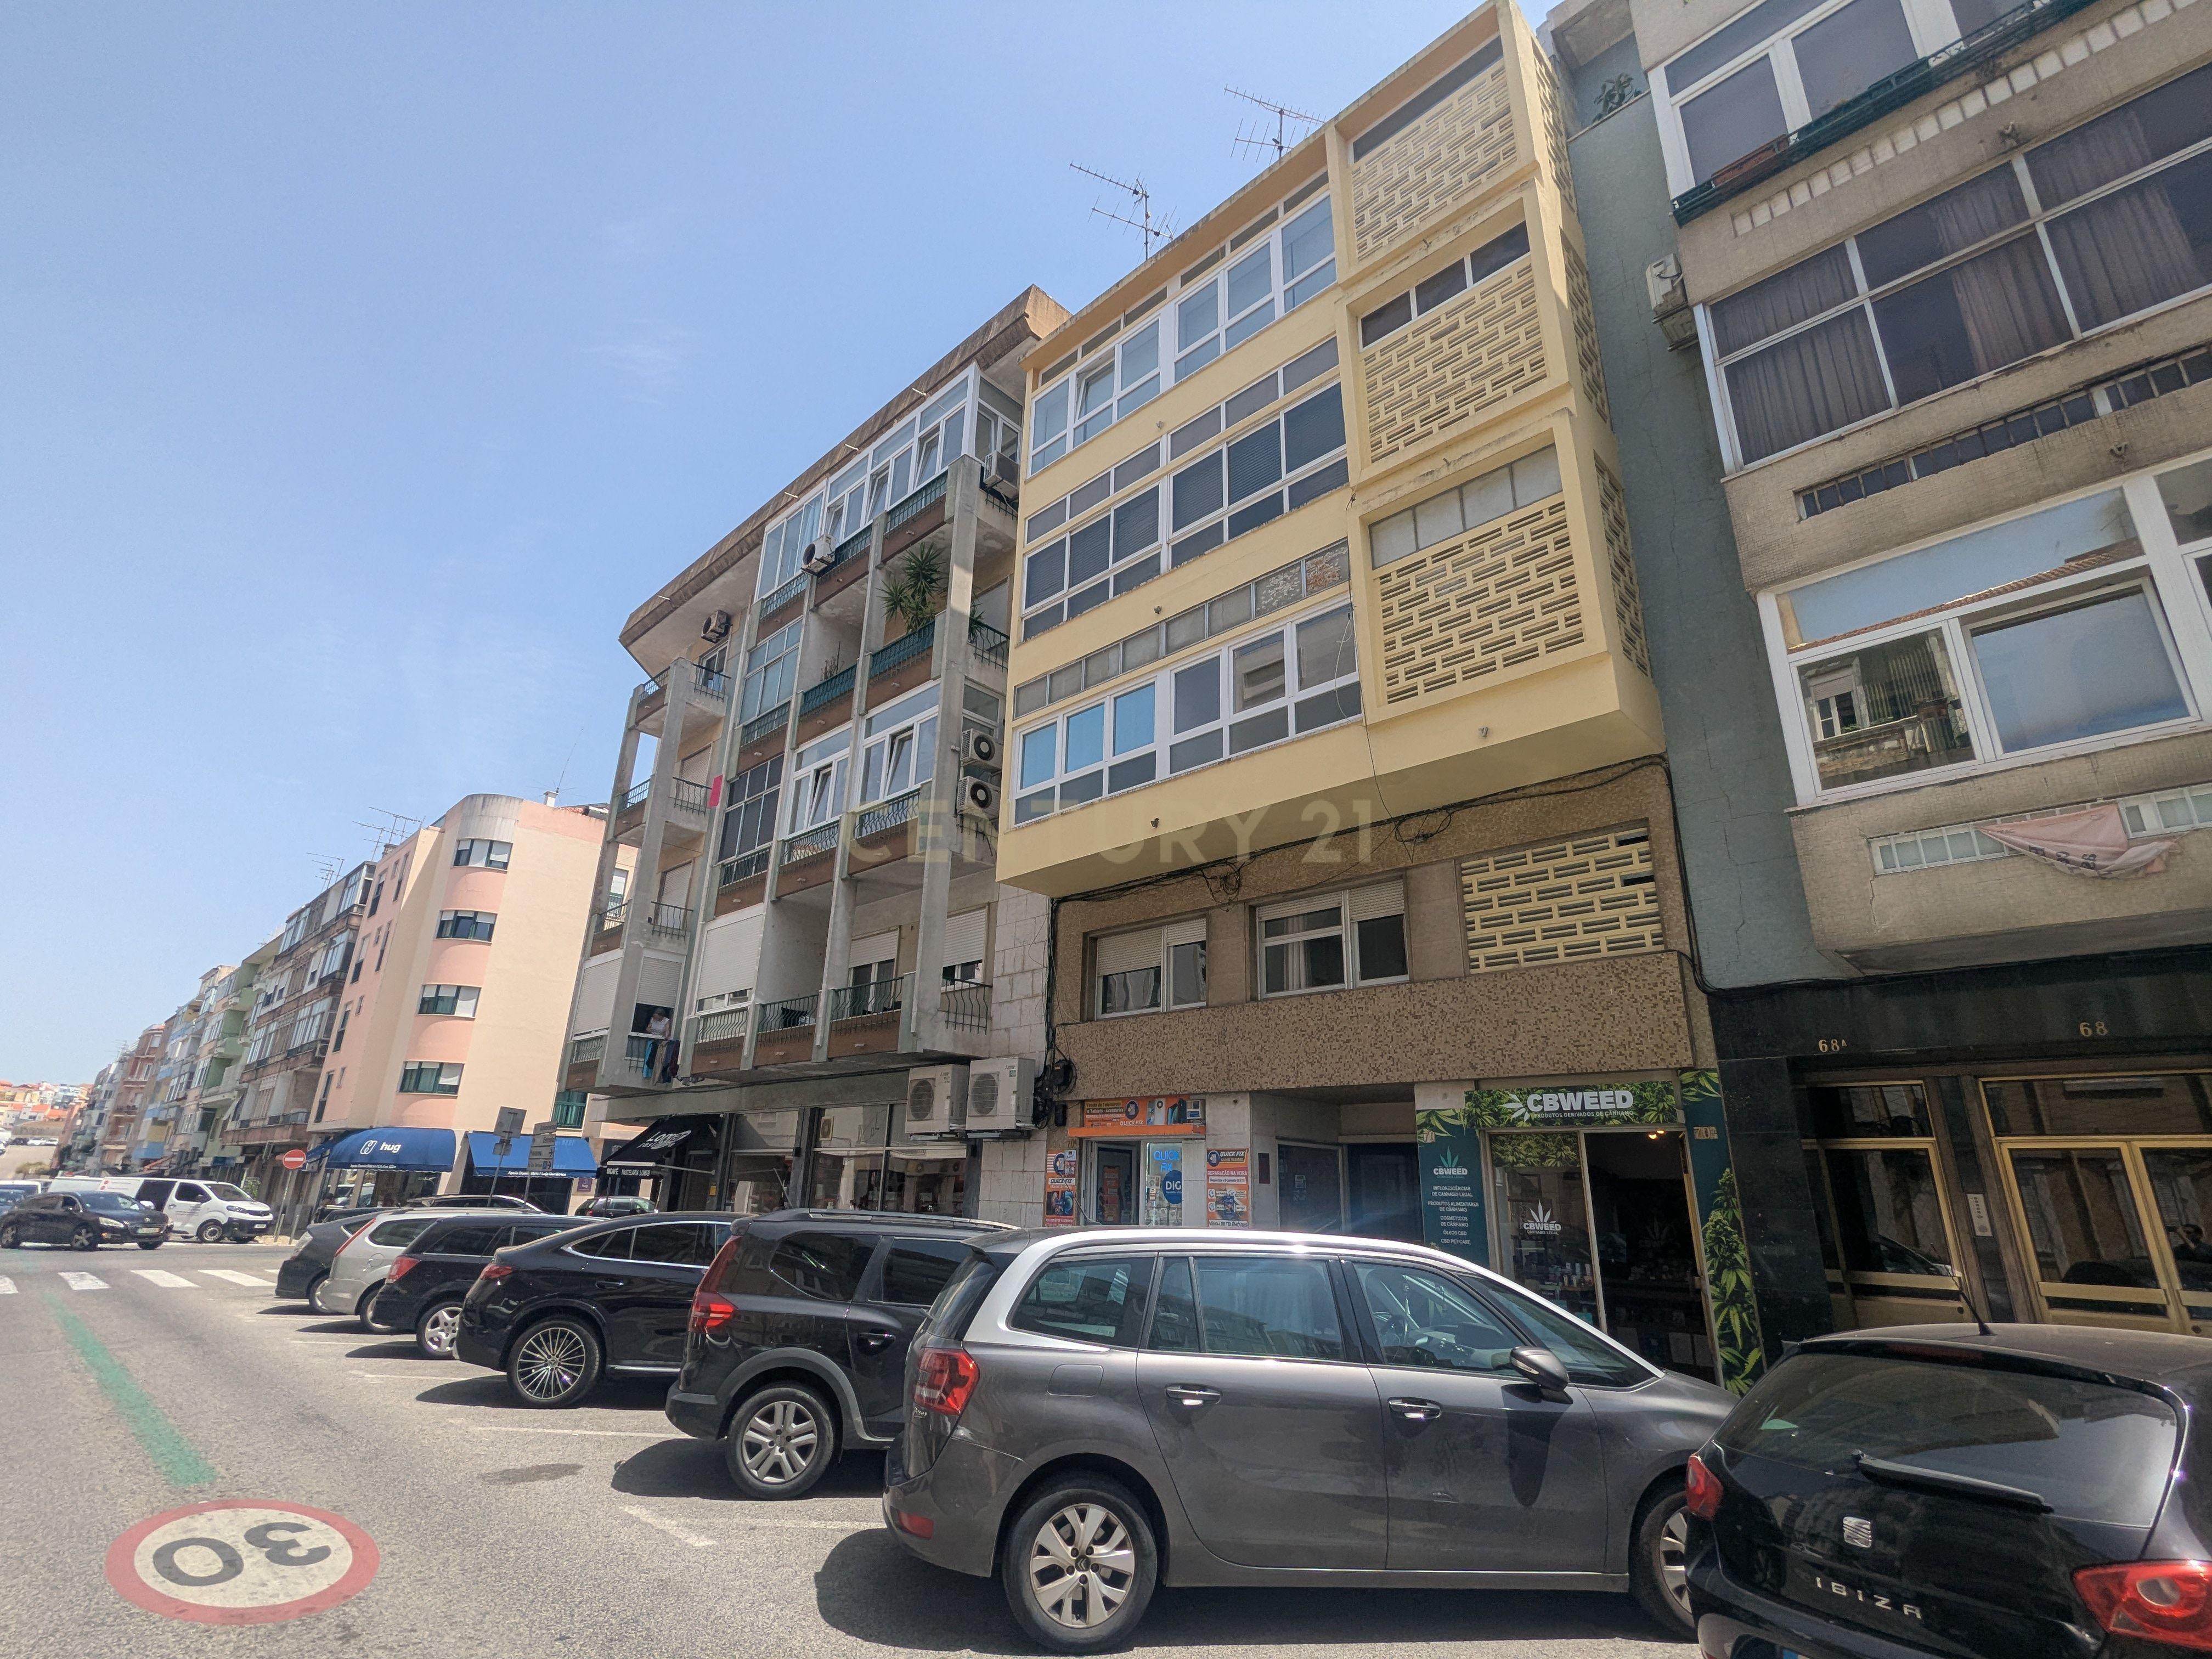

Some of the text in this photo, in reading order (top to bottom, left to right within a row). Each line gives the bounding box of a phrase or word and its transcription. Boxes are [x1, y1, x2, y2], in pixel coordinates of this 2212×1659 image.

[2080, 1021, 2108, 1037] 68
[1819, 1039, 1847, 1053] 68A
[1527, 1090, 1634, 1112] CBWEED
[380, 1142, 402, 1153] hug
[1154, 1150, 1180, 1161] QUICK
[1523, 1222, 1562, 1231] CBWEED
[153, 1522, 331, 1587] 30
[1816, 1577, 1922, 1620] IBIZA
